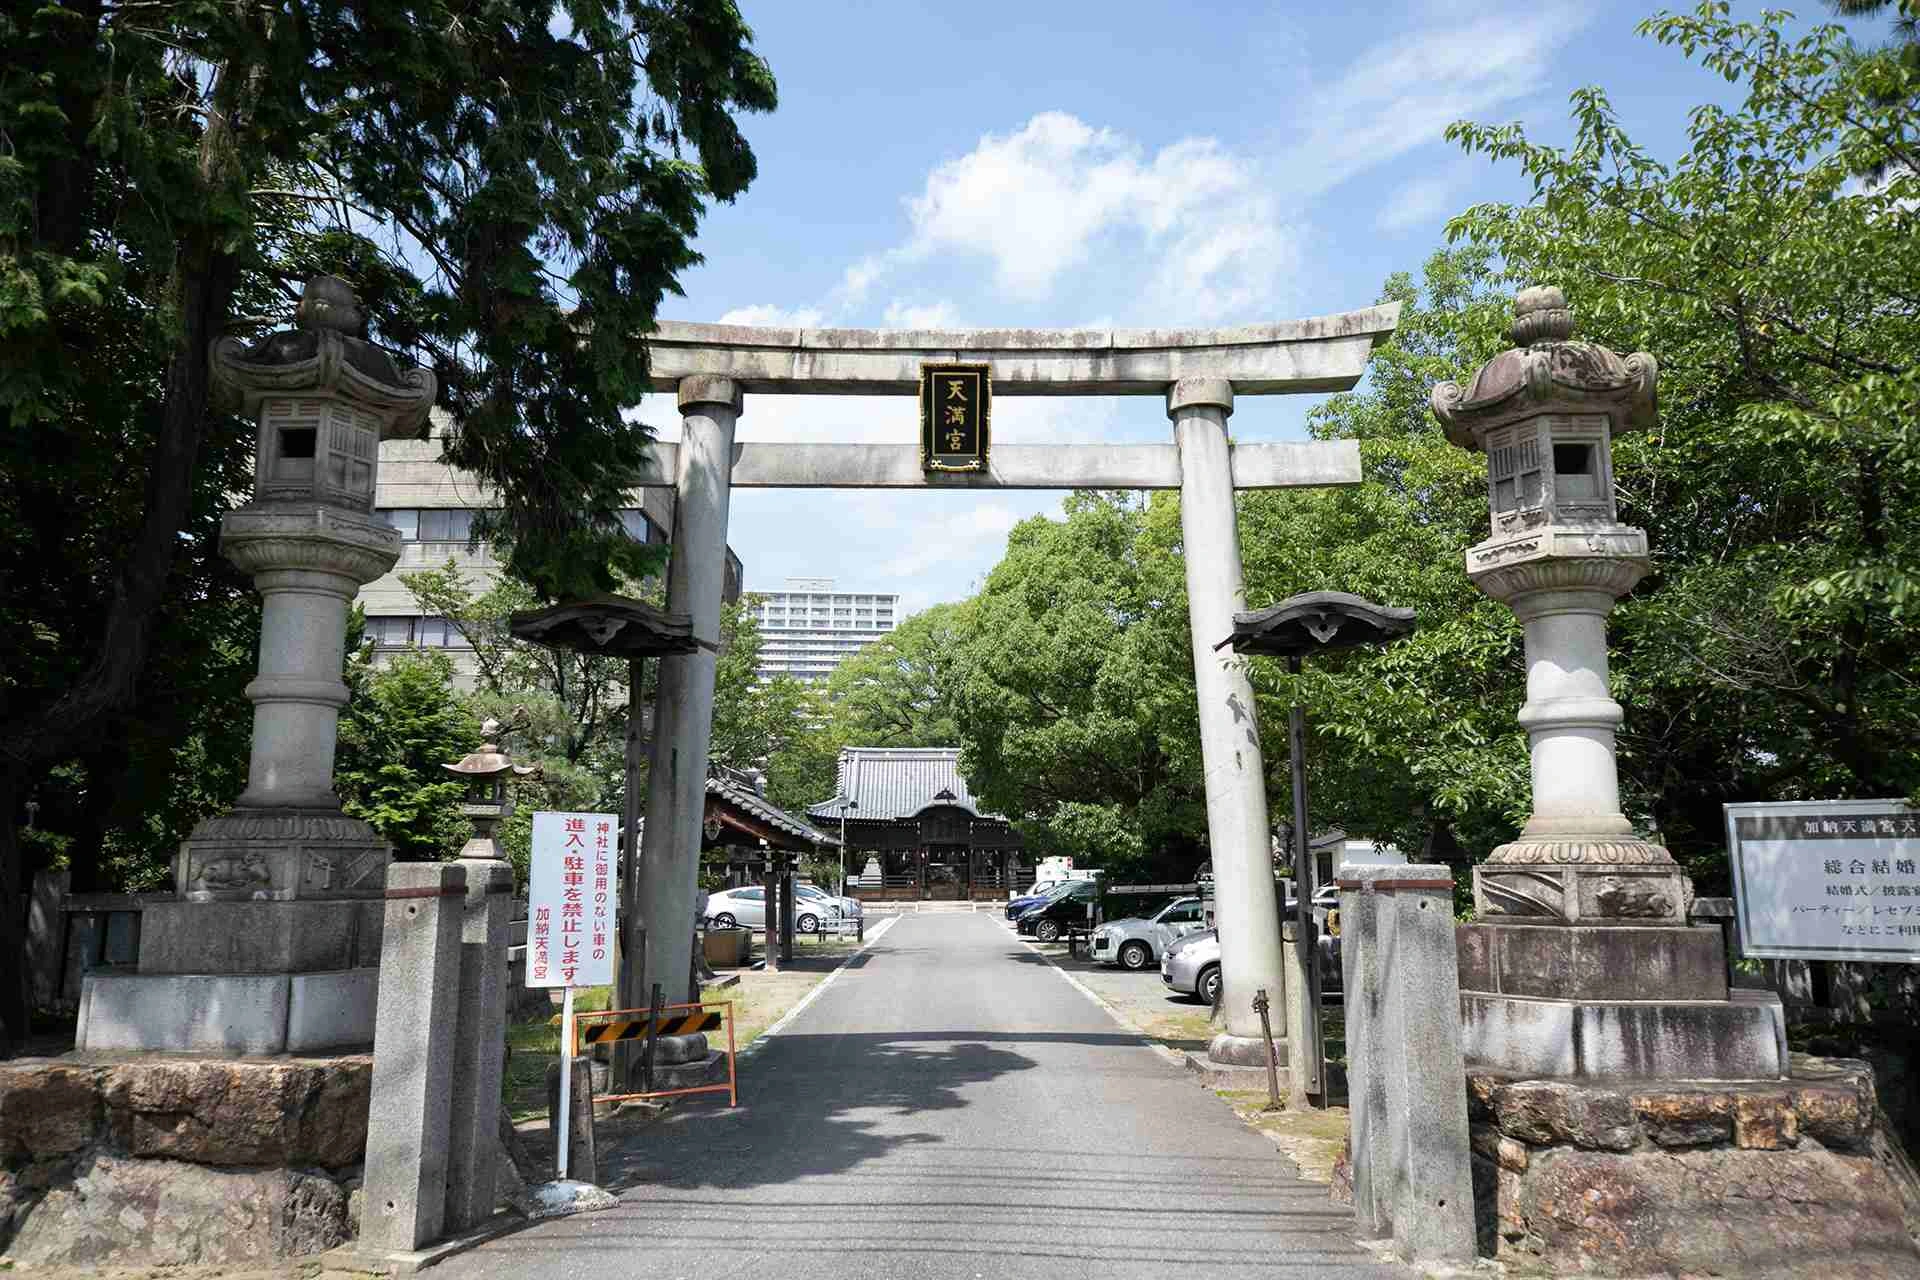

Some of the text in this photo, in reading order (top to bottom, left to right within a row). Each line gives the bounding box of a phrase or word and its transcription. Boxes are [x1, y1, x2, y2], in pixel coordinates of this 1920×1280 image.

[1804, 818, 1920, 834] 加納天満宮天
[560, 818, 586, 982] 進入・駐車を禁止します
[592, 821, 610, 960] 神社に御用のない車の
[1823, 858, 1916, 875] 総合結婚
[533, 907, 550, 980] 加納天満宮
